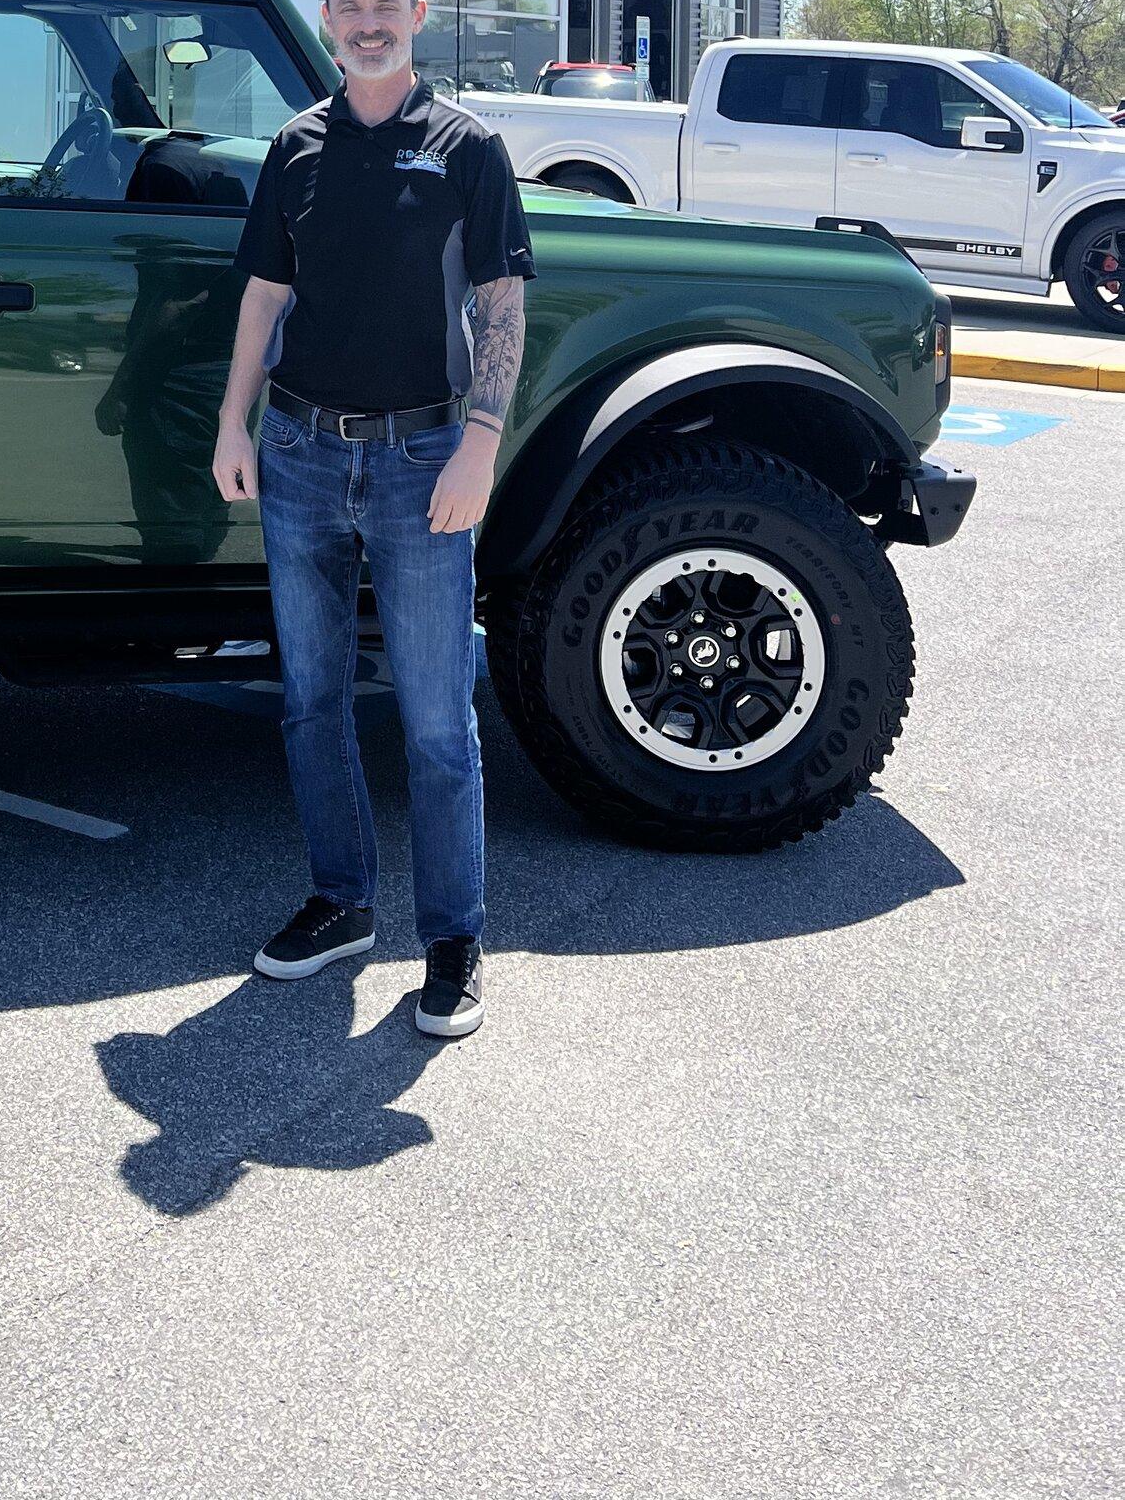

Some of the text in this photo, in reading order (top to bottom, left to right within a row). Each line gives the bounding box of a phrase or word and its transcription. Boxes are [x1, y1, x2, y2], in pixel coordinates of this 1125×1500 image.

[476, 111, 513, 119] HELBY
[956, 243, 1016, 256] SHELBY
[563, 510, 759, 647] GOODYEAR
[785, 536, 852, 609] TERRITORY
